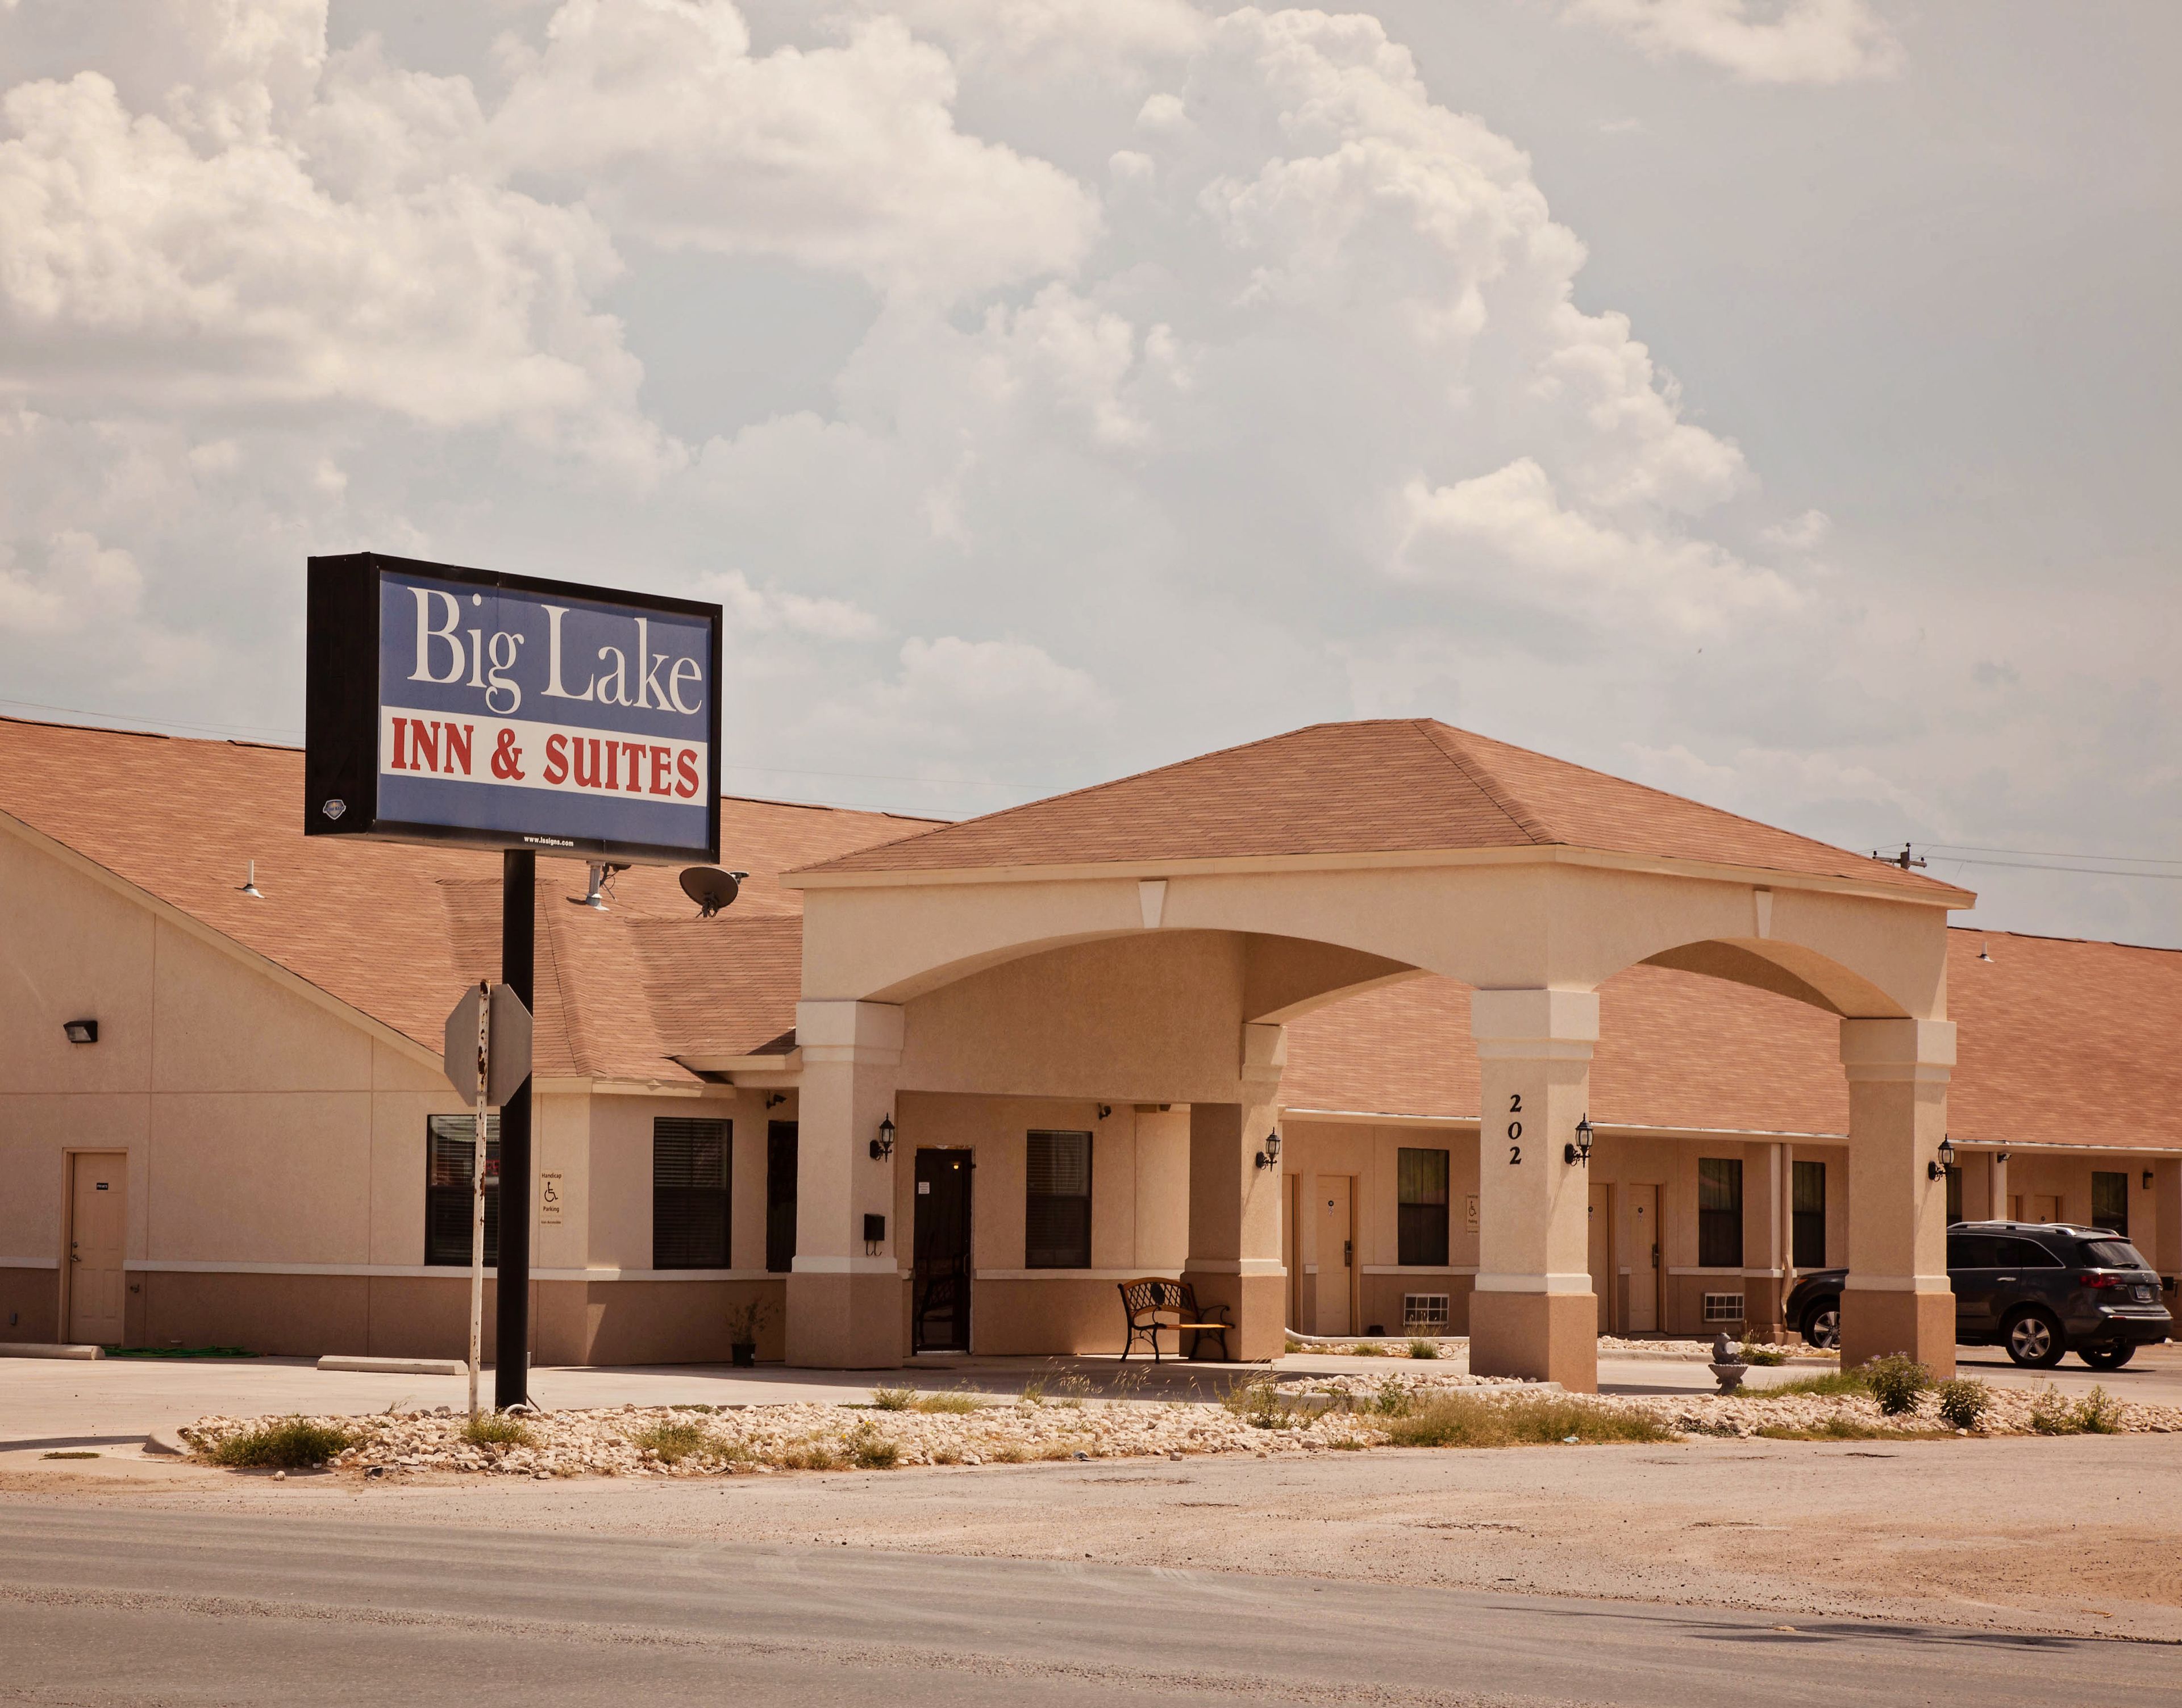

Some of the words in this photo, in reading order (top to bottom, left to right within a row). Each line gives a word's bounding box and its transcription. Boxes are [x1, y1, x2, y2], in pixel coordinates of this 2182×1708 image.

[407, 586, 524, 714] Big
[540, 604, 702, 715] Lake
[391, 717, 474, 776] INN
[490, 728, 525, 781] &
[543, 734, 699, 798] SUITES
[1508, 1094, 1522, 1165] 202
